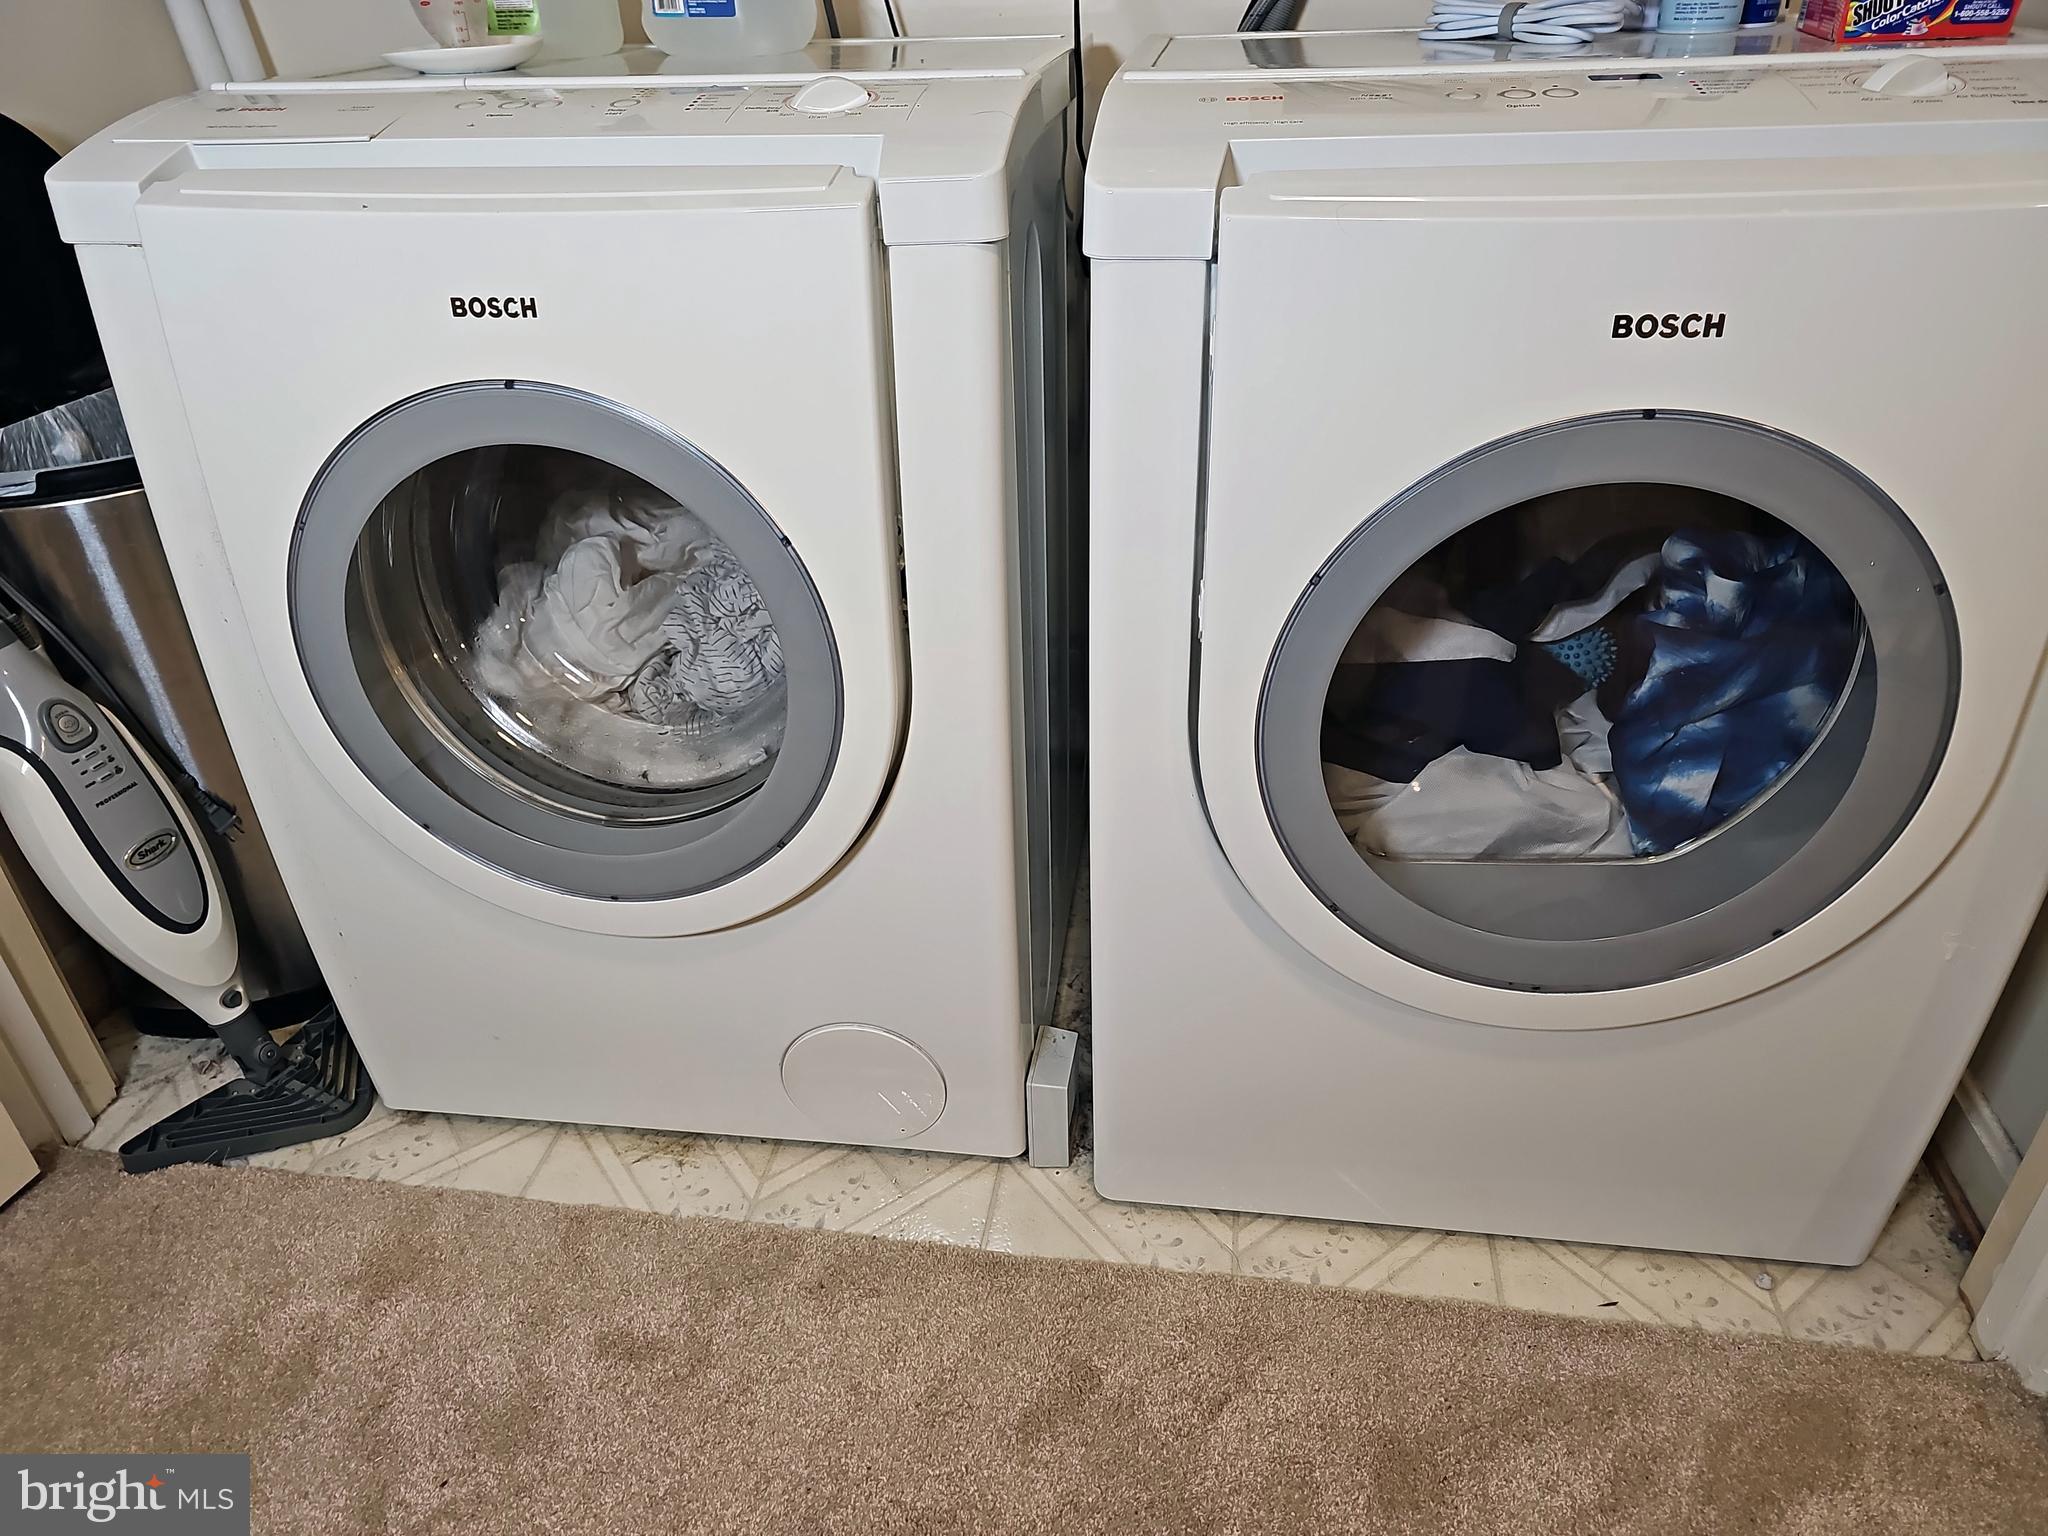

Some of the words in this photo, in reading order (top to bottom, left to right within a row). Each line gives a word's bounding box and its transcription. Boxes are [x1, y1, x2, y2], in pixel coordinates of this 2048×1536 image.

[449, 296, 538, 319] BOSCH
[1611, 313, 1726, 339] BOSCH
[95, 781, 138, 809] PROFESSIONAL
[137, 839, 168, 860] Shark
